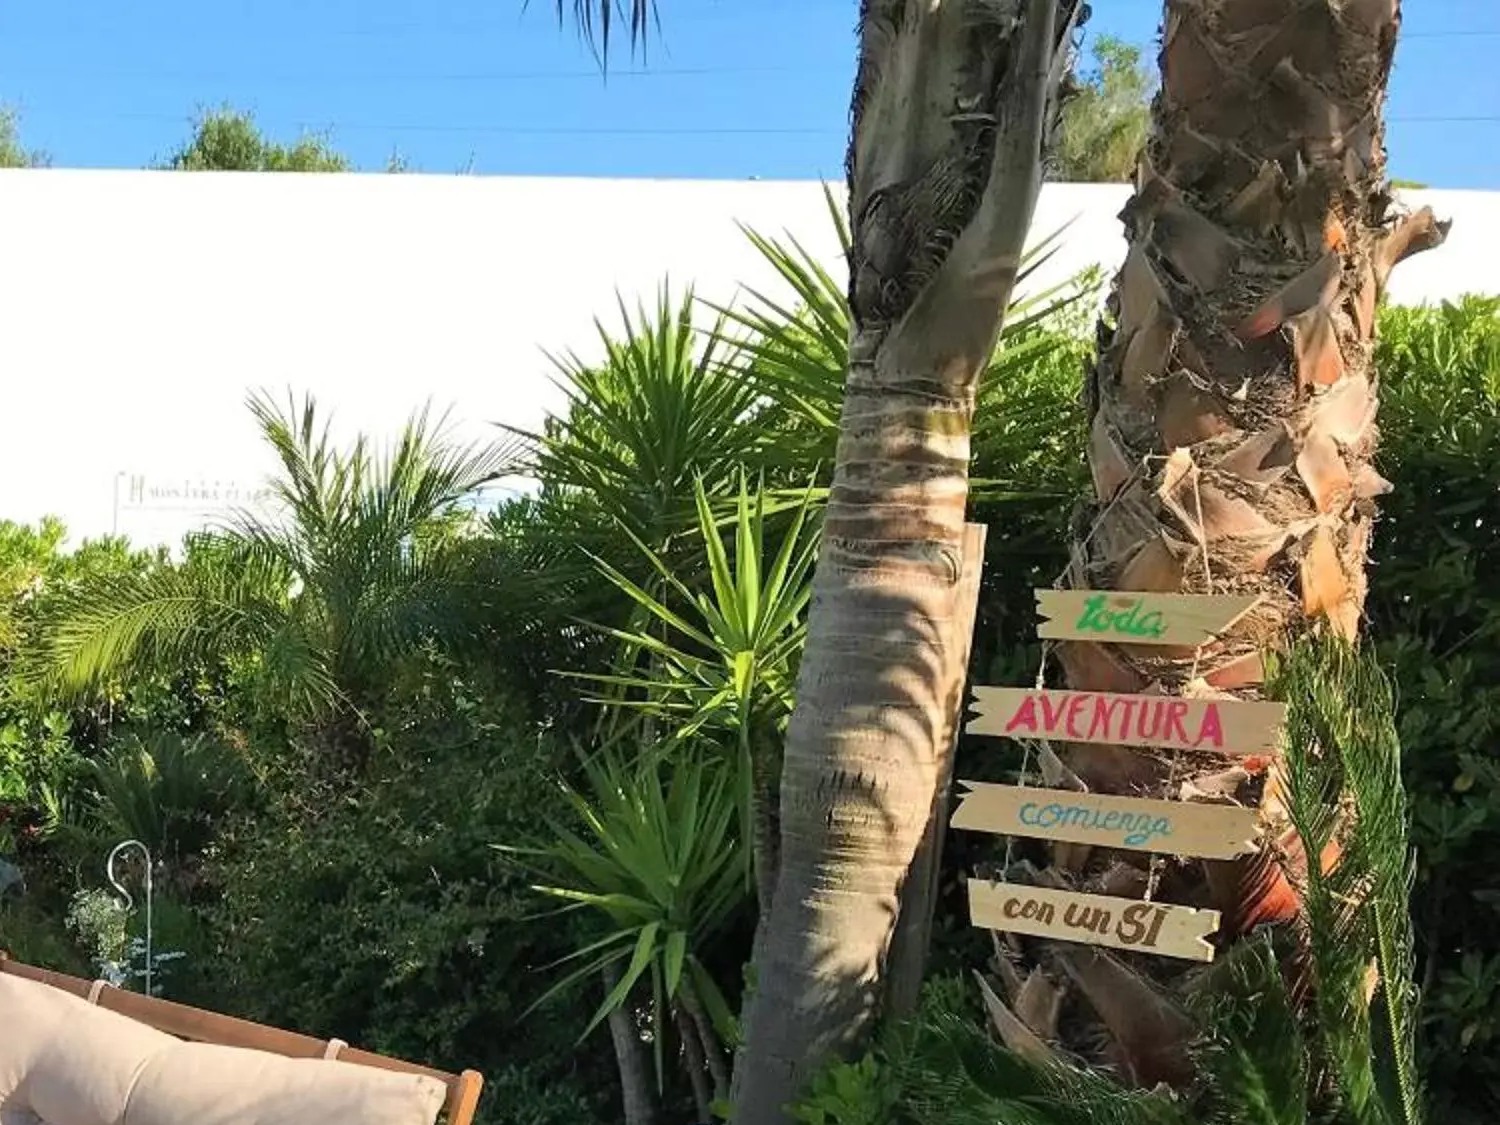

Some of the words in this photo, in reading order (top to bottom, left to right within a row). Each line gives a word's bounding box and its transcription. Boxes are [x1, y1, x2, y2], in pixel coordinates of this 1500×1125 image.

[1005, 688, 1225, 747] AVENTURA
[1019, 802, 1173, 845] comienza
[1003, 897, 1056, 926] con
[1064, 902, 1112, 935] un
